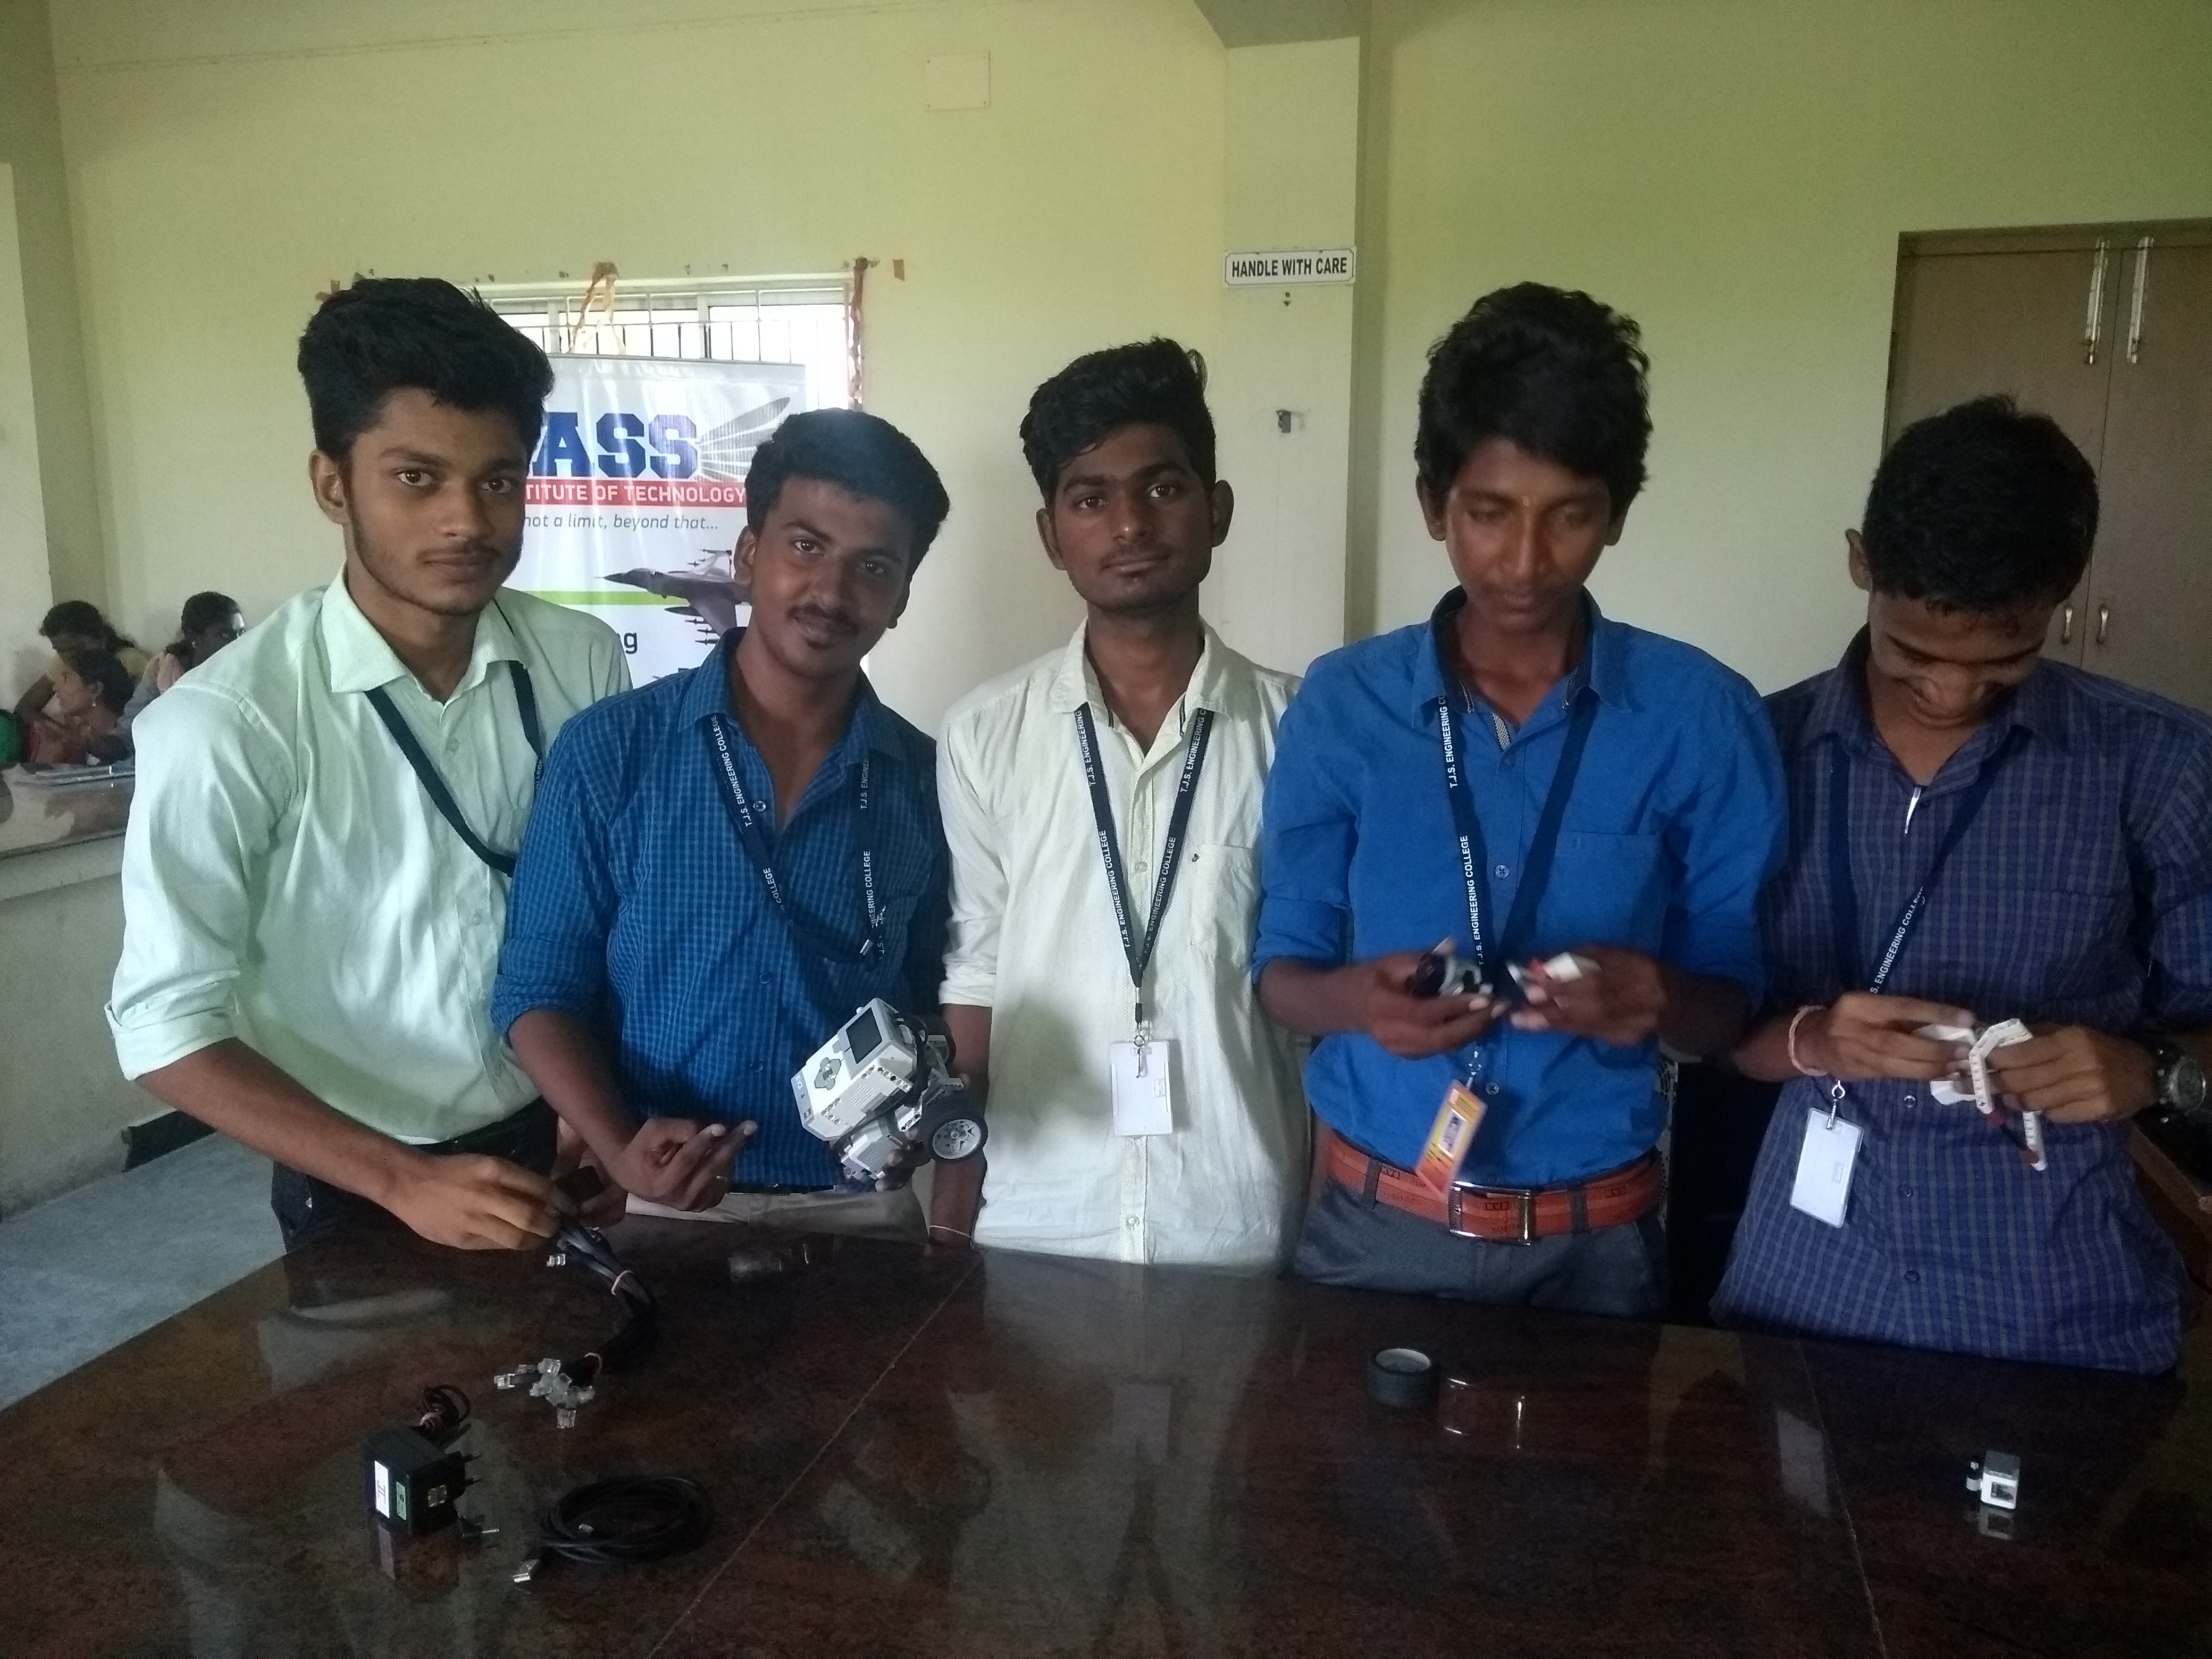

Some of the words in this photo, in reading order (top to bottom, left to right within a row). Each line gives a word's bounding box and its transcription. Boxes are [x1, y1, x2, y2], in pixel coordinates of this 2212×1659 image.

[1231, 259, 1278, 278] HANDLE
[1281, 258, 1312, 276] WITH
[1316, 257, 1347, 274] CARE
[594, 485, 618, 501] OF
[624, 485, 746, 504] TECHNOLOGY
[554, 516, 563, 527] a
[568, 513, 607, 530] limit,
[614, 514, 669, 532] beyond
[711, 715, 727, 751] COLLEGE
[1074, 710, 1092, 764] ENGINEERING
[1186, 716, 1206, 771] ENGINEERING
[1439, 706, 1454, 763] ENGINEERING
[722, 752, 745, 805] ENGINEERING
[1086, 763, 1096, 786] T.J.S.
[1180, 772, 1193, 793] T.J.S.
[1447, 764, 1458, 789] T.J.S.
[1099, 830, 1112, 869] COLLEGE
[1460, 835, 1473, 878] COLLEGE
[763, 867, 782, 903] COLLEGE
[864, 851, 873, 888] COLLEGE
[1149, 875, 1166, 932] ENGINEERING
[1161, 836, 1176, 875] COLLEGE
[1108, 869, 1126, 925] ENGINEERING
[1467, 879, 1481, 940] ENGINEERING
[1120, 925, 1130, 948] T.J.S.
[1476, 942, 1484, 966] T.J.S.
[1874, 926, 1906, 984] ENGINEERING
